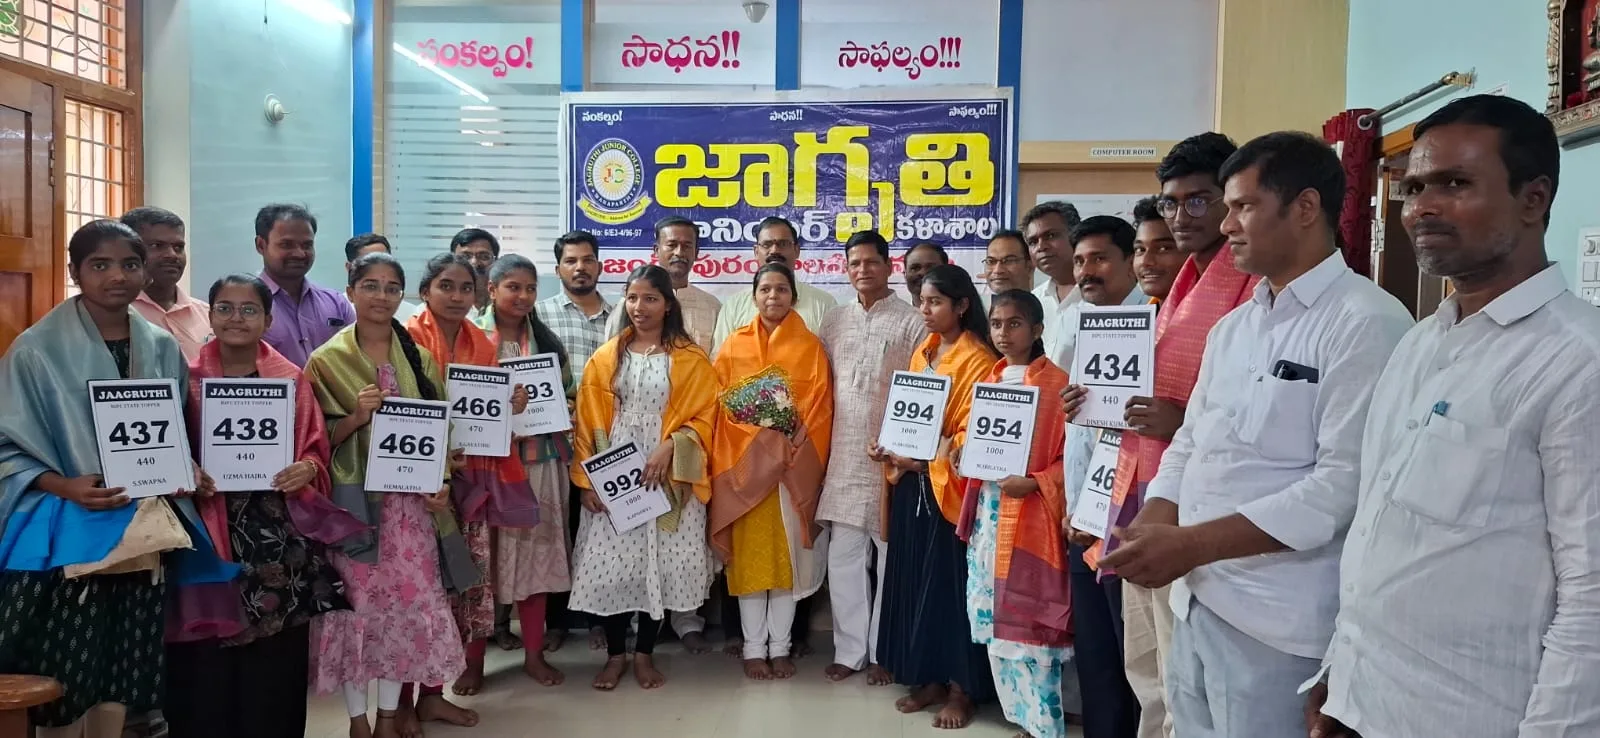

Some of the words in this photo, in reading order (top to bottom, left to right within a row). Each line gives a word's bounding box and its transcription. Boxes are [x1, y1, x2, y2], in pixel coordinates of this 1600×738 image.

[621, 30, 740, 73] సాధన!!
[601, 142, 627, 152] JUNIOR
[1083, 318, 1146, 328] JAAGRUTHI
[1084, 353, 1140, 381] 434
[451, 371, 506, 383] JAAGRUTHI
[896, 376, 943, 389] JAAGRUTHI
[98, 389, 169, 400] JAAGRUTHI
[210, 387, 283, 397] JAAGRUTHI
[525, 382, 554, 399] 93
[978, 390, 1031, 402] JAAGRUTHI
[1102, 396, 1118, 404] 440
[380, 405, 443, 417] JAAGRUTHI
[452, 396, 501, 417] 466
[893, 400, 934, 422] 994
[109, 420, 169, 446] 437
[213, 418, 278, 440] 438
[468, 425, 483, 433] 470
[901, 427, 917, 435] 1000
[976, 416, 1023, 440] 954
[379, 432, 436, 456] 466
[236, 452, 255, 461] 440
[986, 446, 1004, 455] 1000
[137, 456, 155, 466] 440
[590, 446, 635, 471] JAAGRUTHI
[397, 465, 413, 473] 470
[603, 467, 642, 497] 992
